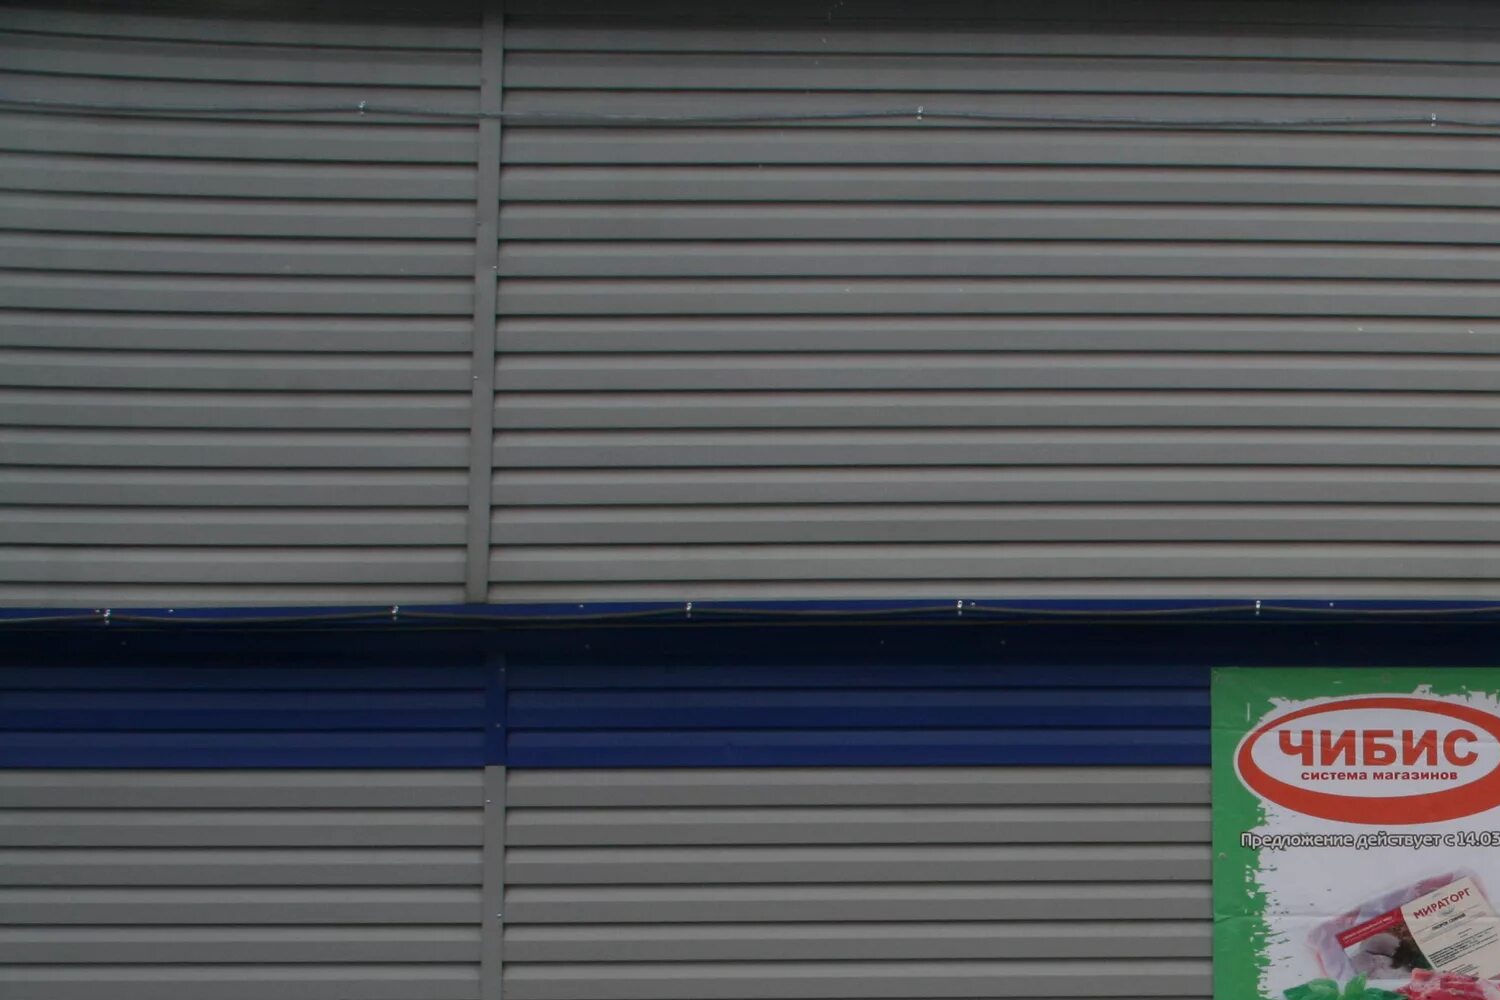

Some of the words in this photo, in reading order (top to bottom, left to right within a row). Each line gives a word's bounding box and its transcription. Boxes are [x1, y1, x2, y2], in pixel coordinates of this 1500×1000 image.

[1278, 728, 1479, 767] ЧИБИС
[1301, 771, 1367, 781] система
[1372, 771, 1458, 781] магазинов
[1240, 831, 1352, 850] Предложение
[1355, 831, 1440, 850] действует
[1444, 835, 1455, 847] с
[1413, 887, 1472, 920] МИРАТОРГ
